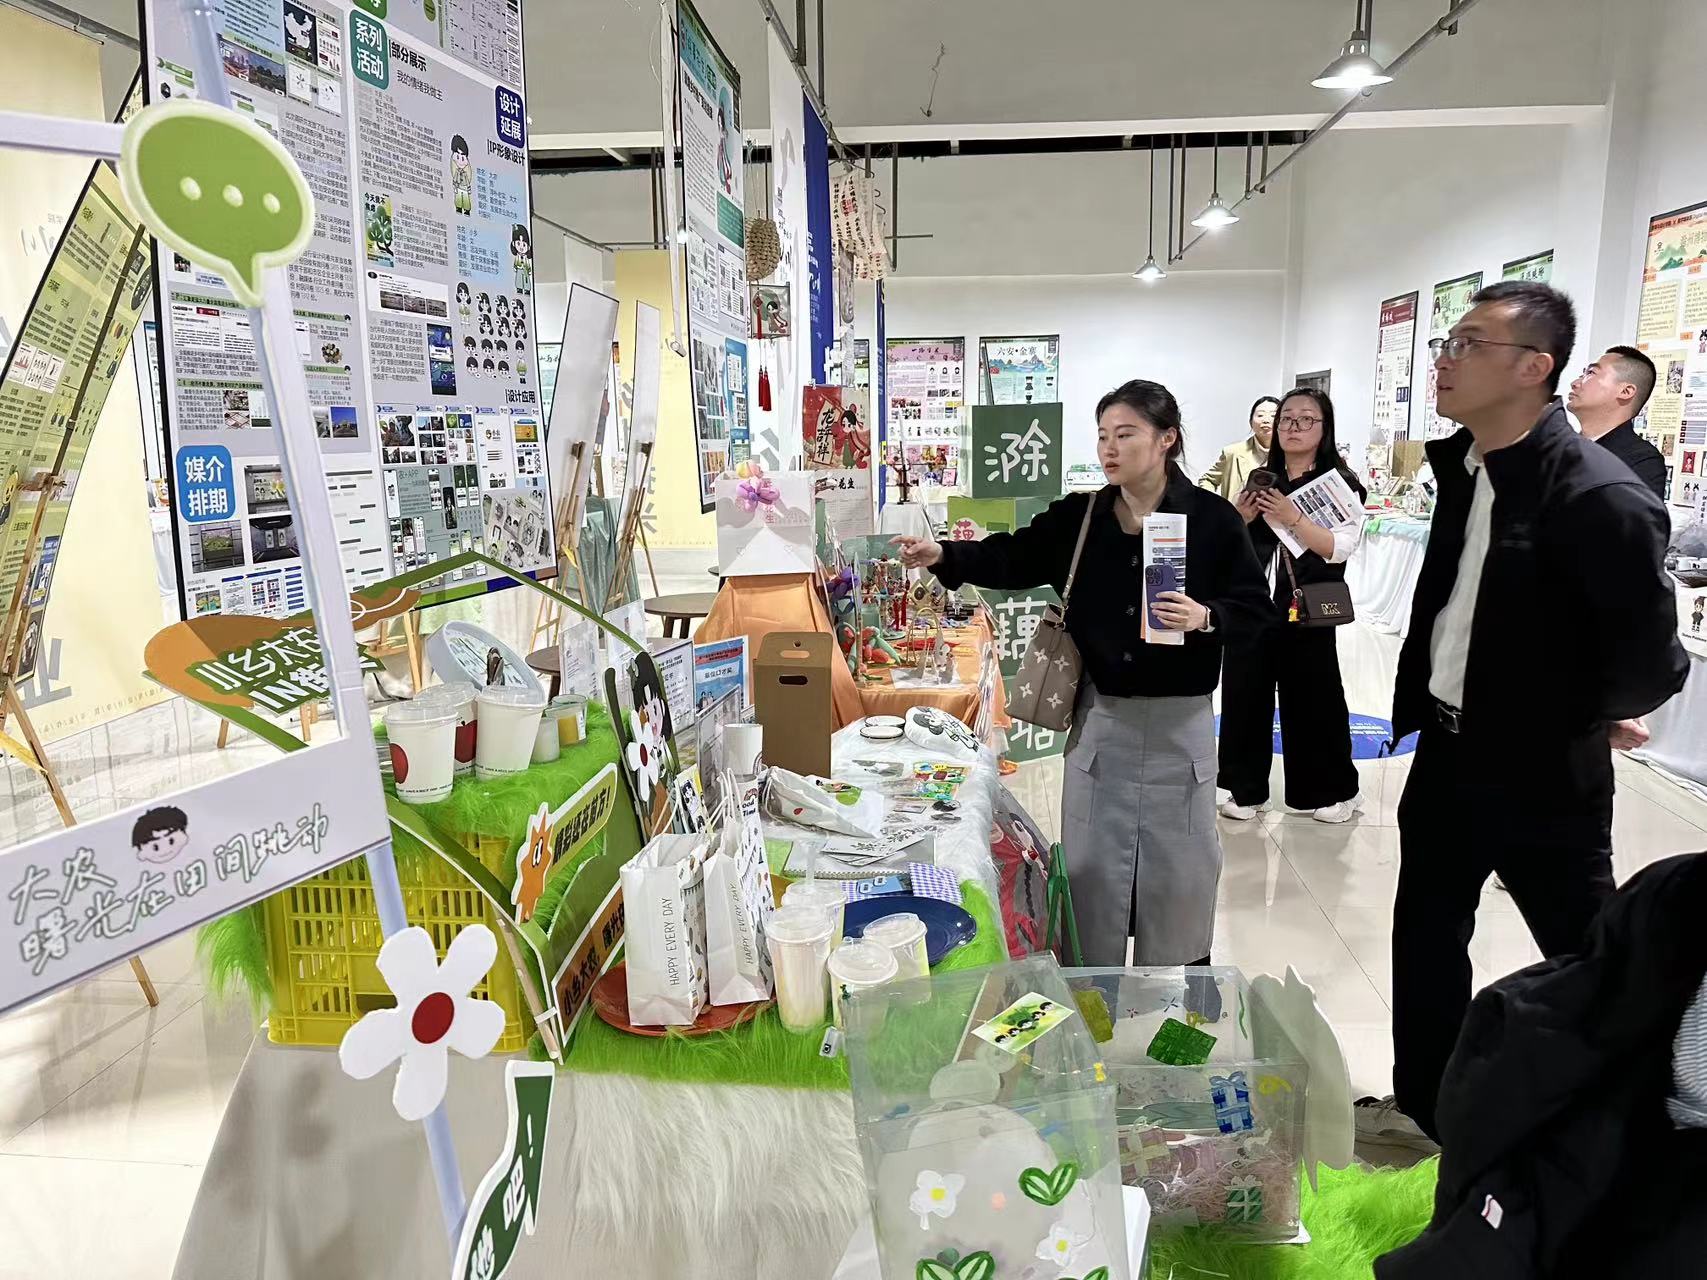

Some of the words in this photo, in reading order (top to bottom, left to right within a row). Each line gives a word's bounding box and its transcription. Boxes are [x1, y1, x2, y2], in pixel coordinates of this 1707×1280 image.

[355, 18, 383, 51] 系列
[356, 47, 384, 80] 活动
[391, 41, 427, 72] 部分展示
[499, 91, 521, 117] 设计
[500, 115, 522, 141] 延展
[507, 389, 536, 404] 设计应用
[984, 418, 1052, 483] 滁
[184, 456, 225, 483] 媒介
[187, 488, 228, 516] 排期
[10, 848, 118, 926] 大农
[20, 803, 329, 976] 曙光在田间跳动
[730, 882, 742, 902] DAY
[662, 897, 674, 917] DAY
[735, 906, 748, 933] EVERY
[663, 919, 678, 952] EVERY
[742, 936, 754, 965] HAPPY
[664, 954, 680, 987] HAPPY
